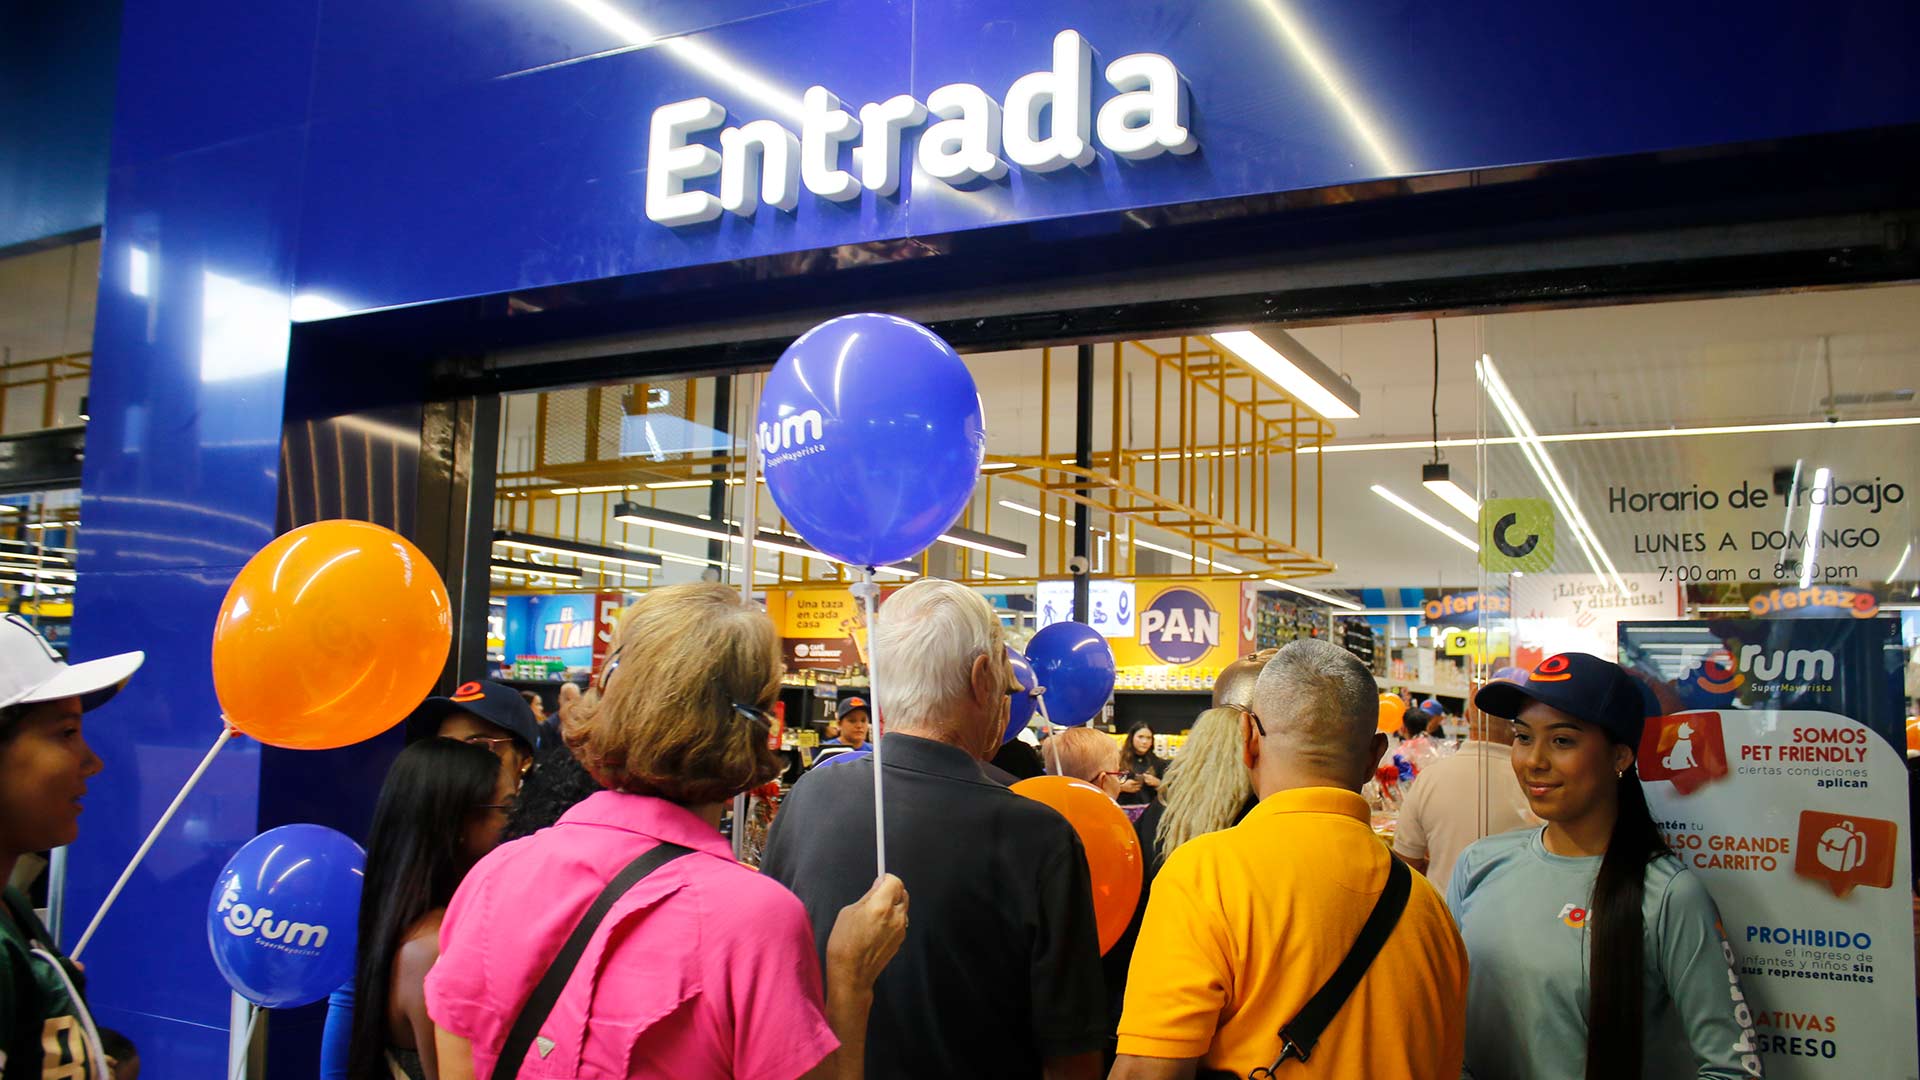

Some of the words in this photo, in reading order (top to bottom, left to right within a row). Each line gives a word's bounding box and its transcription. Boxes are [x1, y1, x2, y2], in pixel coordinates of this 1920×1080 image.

[645, 29, 1198, 227] Entrada
[757, 409, 823, 454] rum
[1608, 483, 1720, 514] Horario
[1728, 481, 1769, 509] de
[1633, 533, 1706, 553] LUNES
[1718, 532, 1738, 551] A
[1751, 527, 1881, 550] DOMNGO
[1748, 567, 1761, 580] a
[797, 600, 818, 609] Una
[821, 600, 844, 609] taza
[1749, 585, 1879, 619] Ofertazo
[598, 600, 620, 643] 5
[797, 612, 810, 620] en
[813, 611, 839, 620] cada
[1243, 590, 1256, 641] 3
[796, 621, 821, 629] casa
[1679, 644, 1835, 693] Forum
[1751, 683, 1833, 692] SuperMayorista
[1793, 728, 1867, 744] SOMOS
[1741, 745, 1772, 761] PET
[1779, 746, 1868, 763] FRIENDLY
[1738, 765, 1782, 776] ciertas
[1787, 767, 1868, 778] condiciones
[1817, 778, 1868, 789] aplican
[1656, 820, 1687, 831] ntén
[1691, 822, 1704, 831] tu
[1664, 834, 1702, 850] LSO
[1708, 835, 1790, 854] GRANDE
[1693, 853, 1777, 872] CARRITO
[217, 888, 329, 948] Forum
[1746, 926, 1872, 950] PROHIBIDO
[1742, 956, 1794, 968] infantes
[1799, 961, 1807, 969] y
[1812, 961, 1848, 971] niños
[1853, 963, 1873, 973] sin
[1784, 948, 1796, 957] el
[1801, 949, 1851, 962] ingreso
[1856, 952, 1873, 963] de
[1741, 966, 1763, 975] sus
[1768, 968, 1874, 983] representantes
